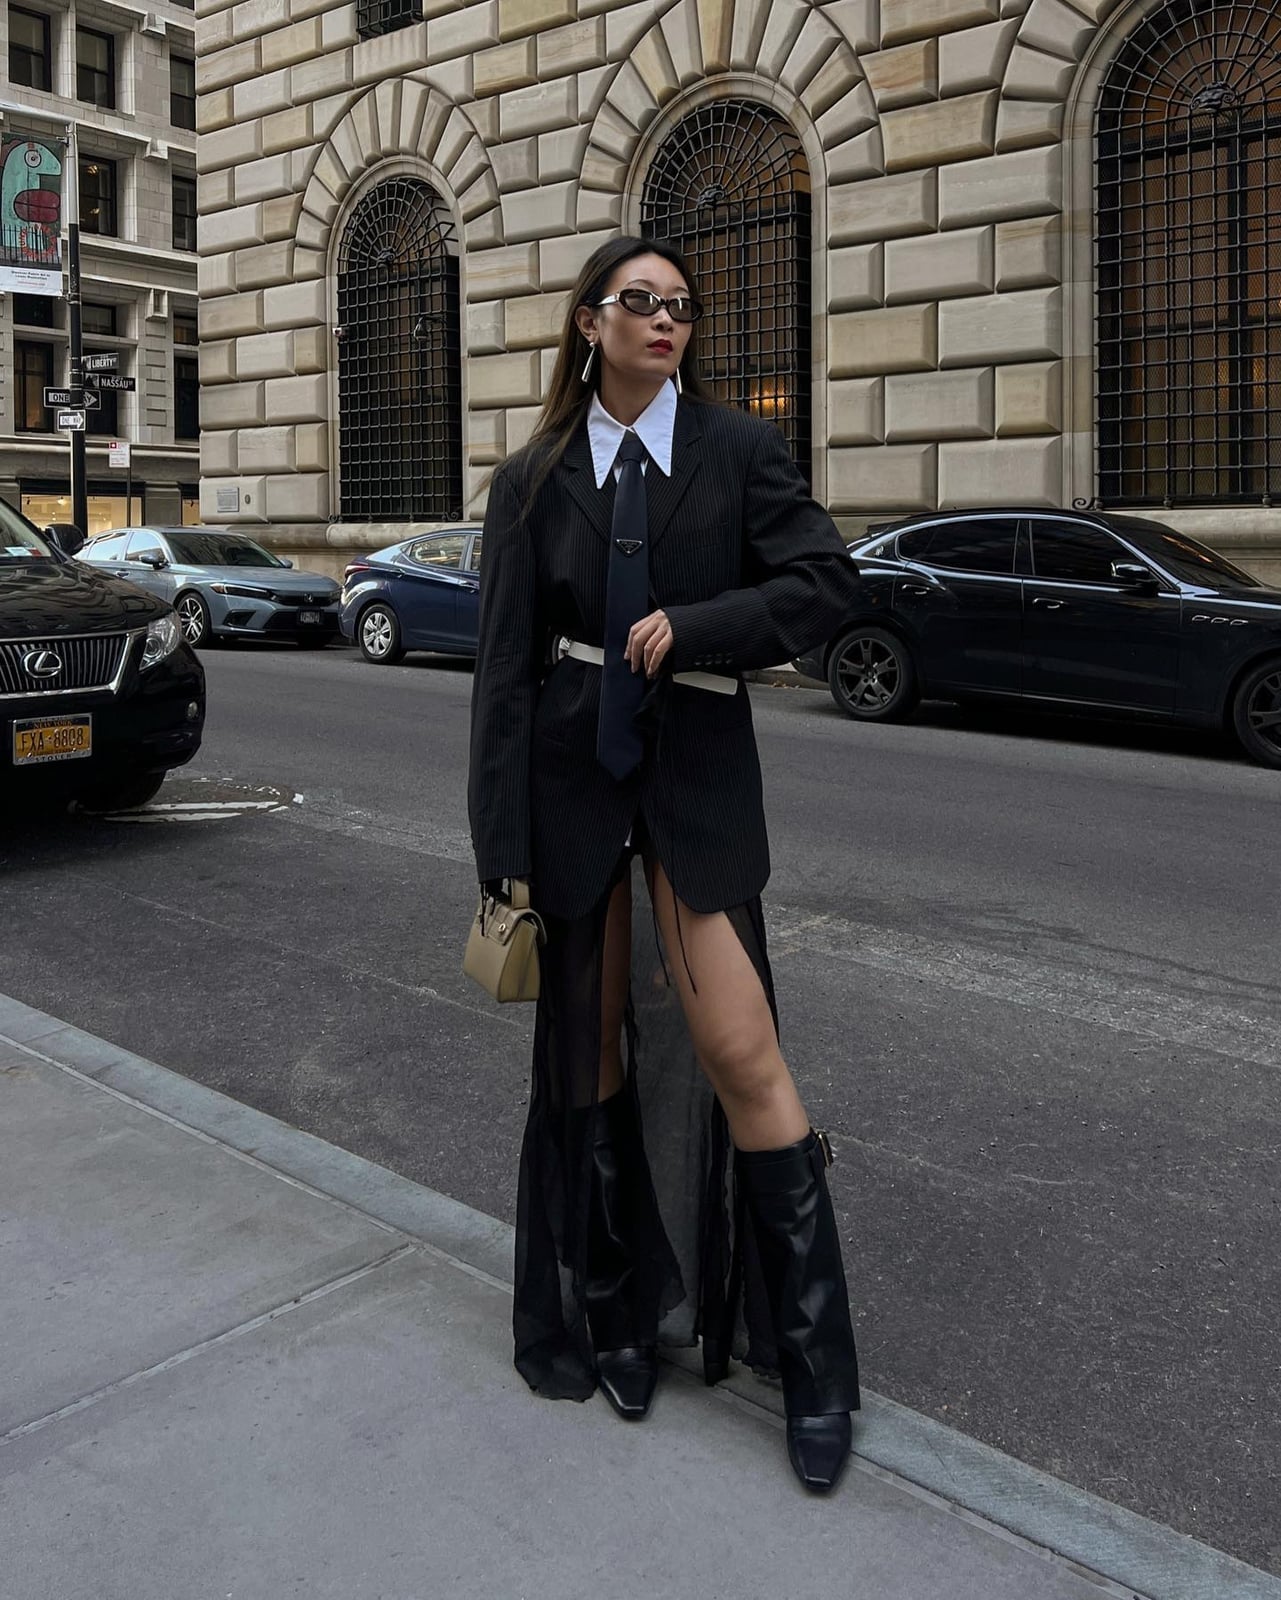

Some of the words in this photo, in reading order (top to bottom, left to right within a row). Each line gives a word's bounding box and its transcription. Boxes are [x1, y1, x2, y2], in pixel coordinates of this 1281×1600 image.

[92, 358, 113, 368] LIBERTY
[101, 378, 128, 389] NASSAU
[52, 394, 70, 402] ONE
